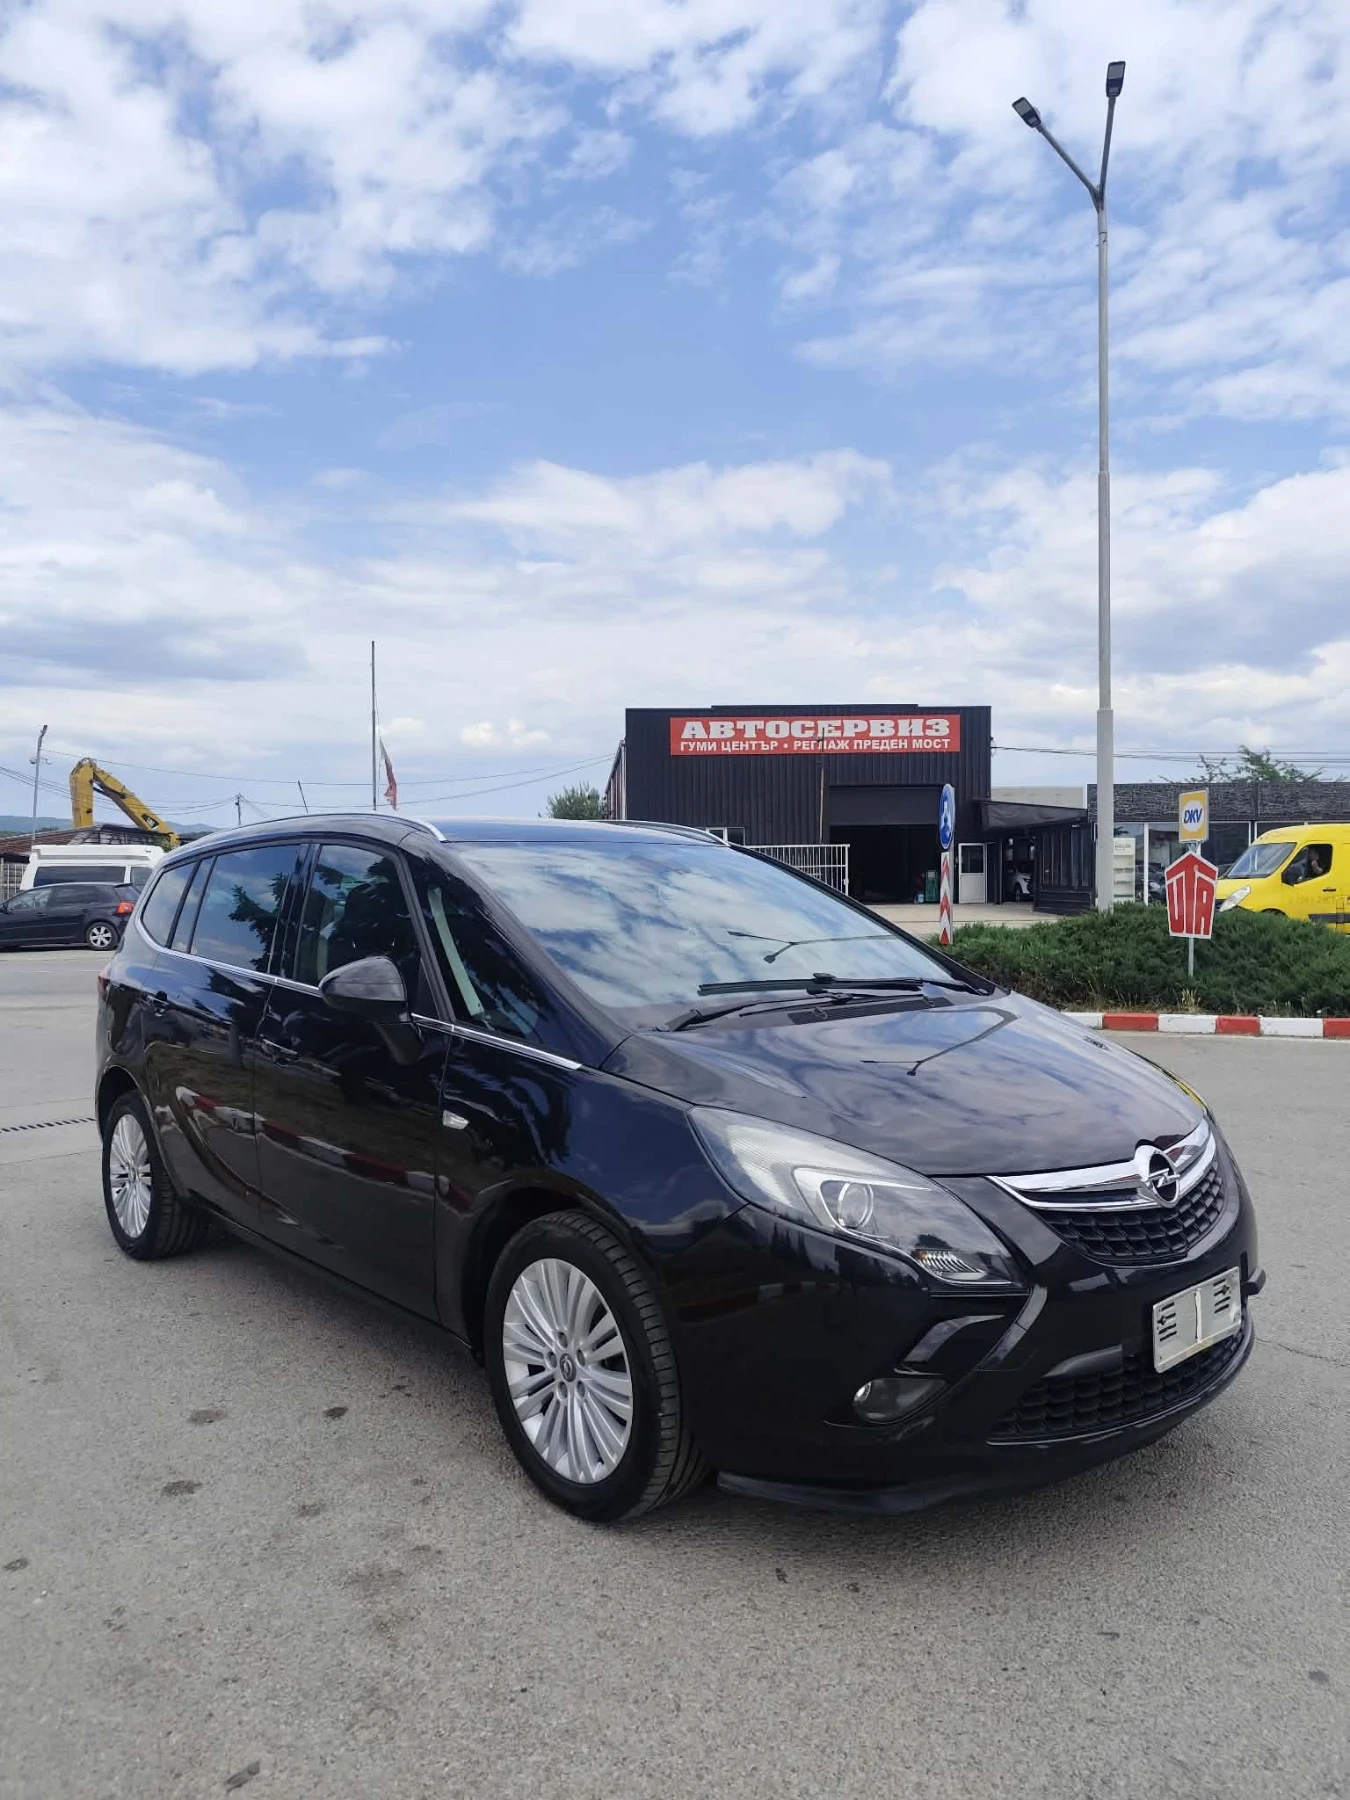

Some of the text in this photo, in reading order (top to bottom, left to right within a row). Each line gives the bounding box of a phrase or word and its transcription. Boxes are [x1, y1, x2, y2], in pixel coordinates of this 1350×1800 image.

[681, 719, 949, 738] АВТОСЕРВИЗ
[680, 741, 717, 751] ГУМИ
[721, 741, 778, 752] ЦЕНТЪР
[854, 739, 907, 750] ПРЕДЕН
[912, 738, 950, 749] МОСТ
[1183, 808, 1202, 824] DKV
[1166, 853, 1217, 936] UTA
